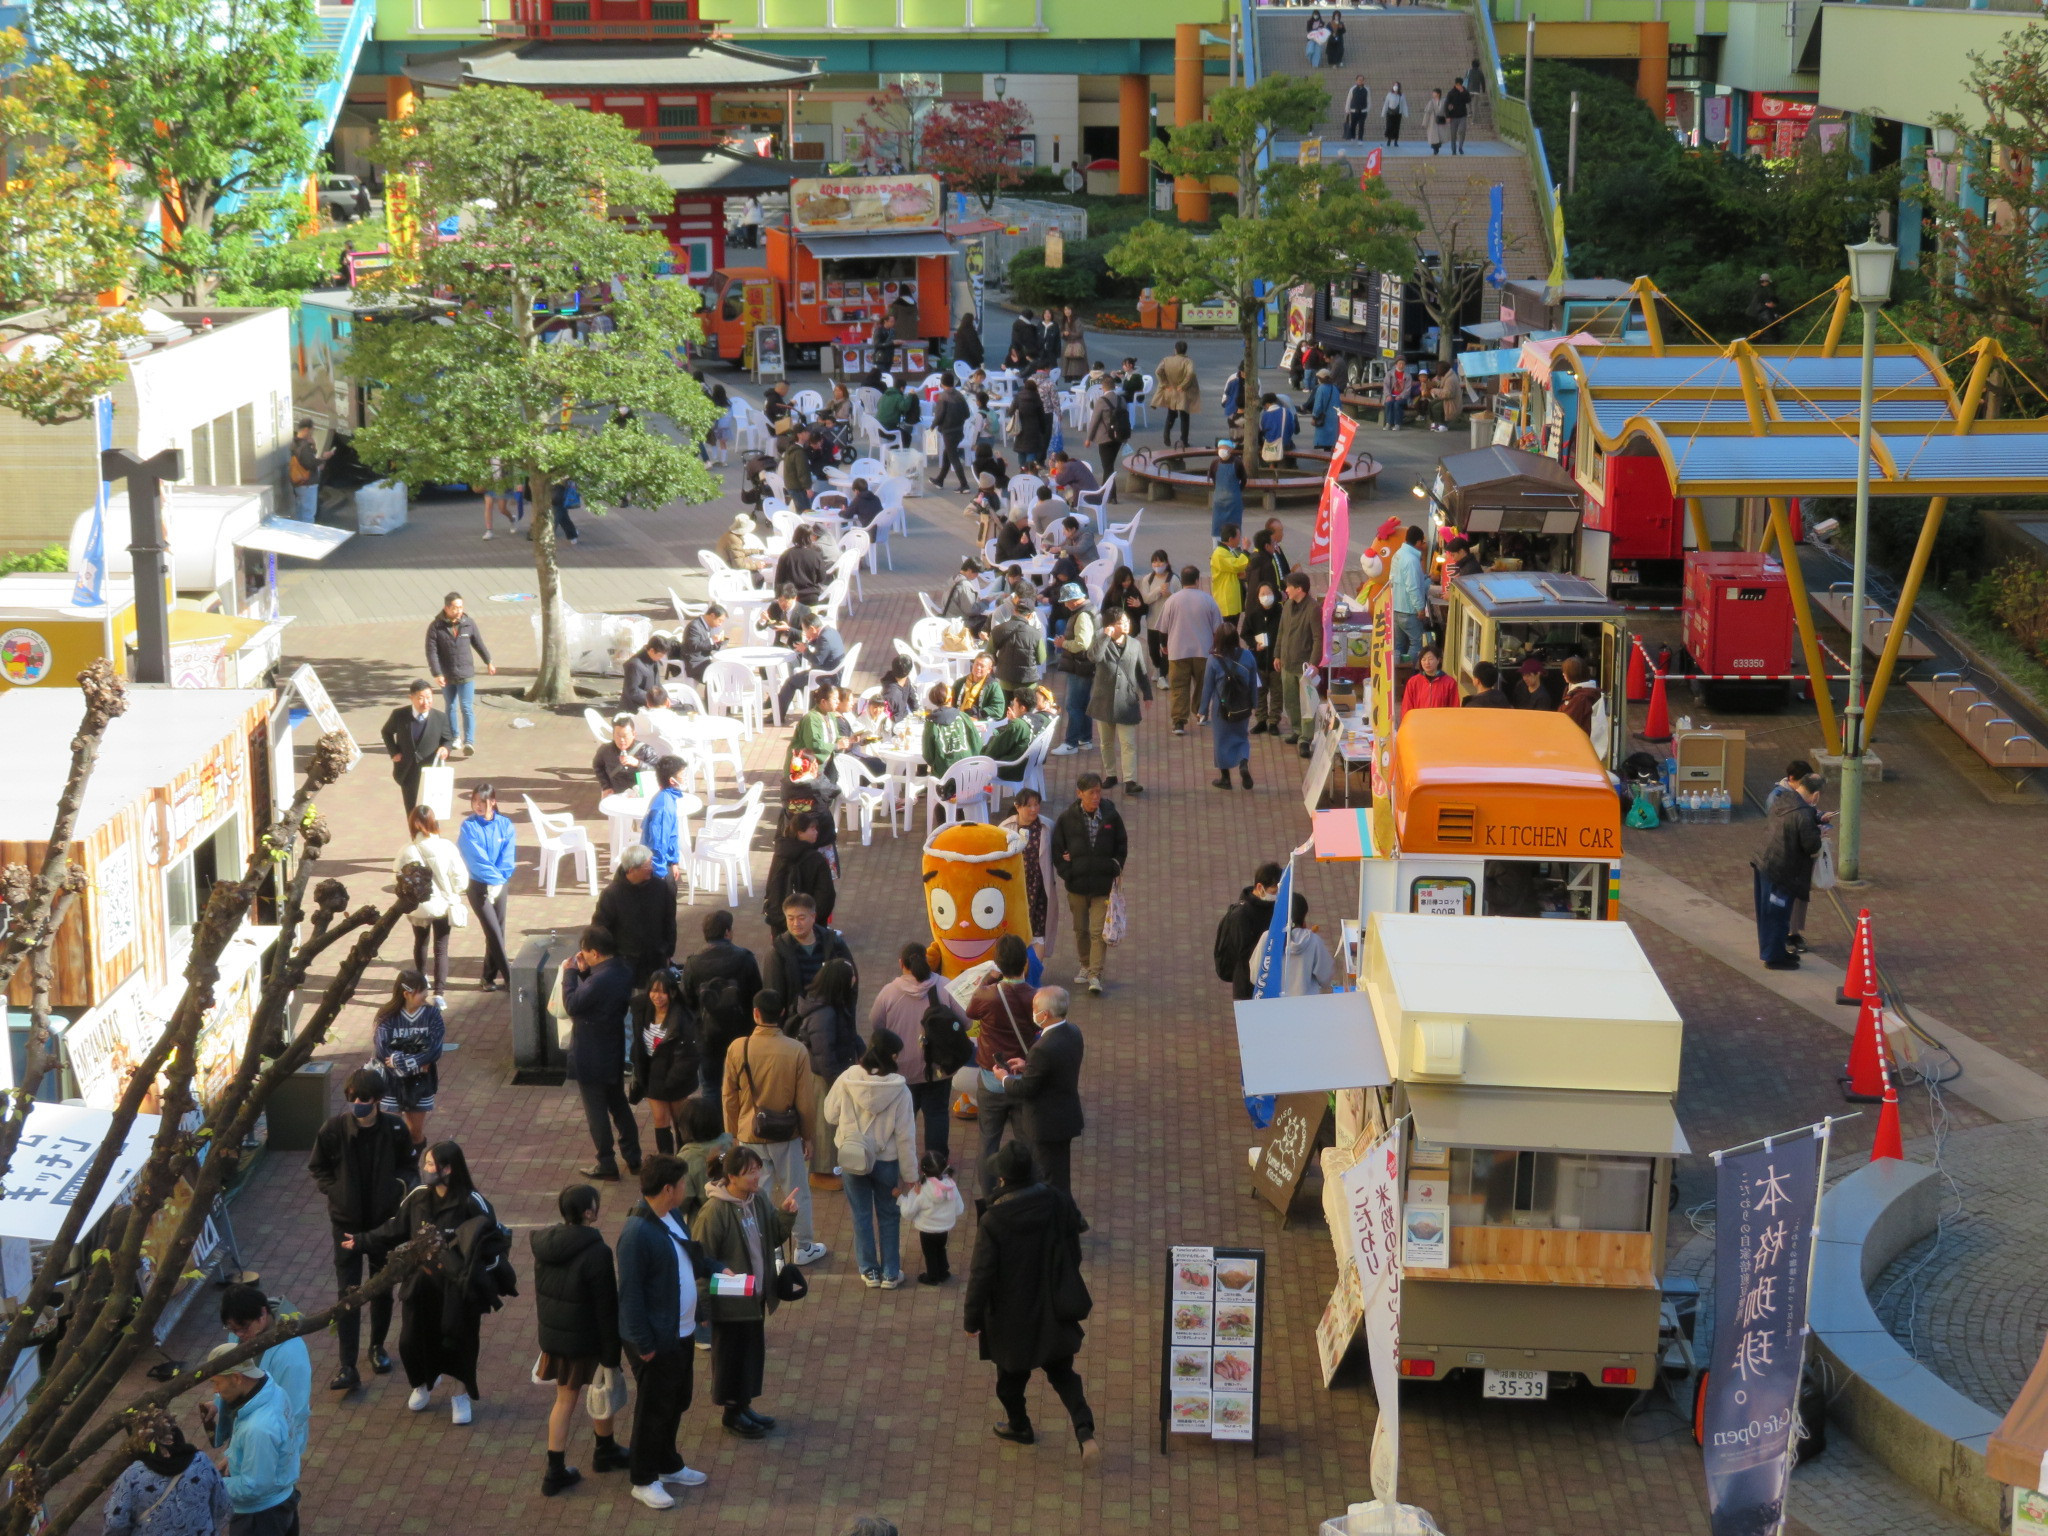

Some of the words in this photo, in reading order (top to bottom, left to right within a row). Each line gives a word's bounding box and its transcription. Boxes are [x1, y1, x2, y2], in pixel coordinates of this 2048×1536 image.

[1711, 106, 1719, 121] 5
[1733, 659, 1764, 668] 633350
[1485, 825, 1567, 847] KITCHEN
[1579, 827, 1614, 848] CAR
[1498, 1380, 1543, 1397] 35-39
